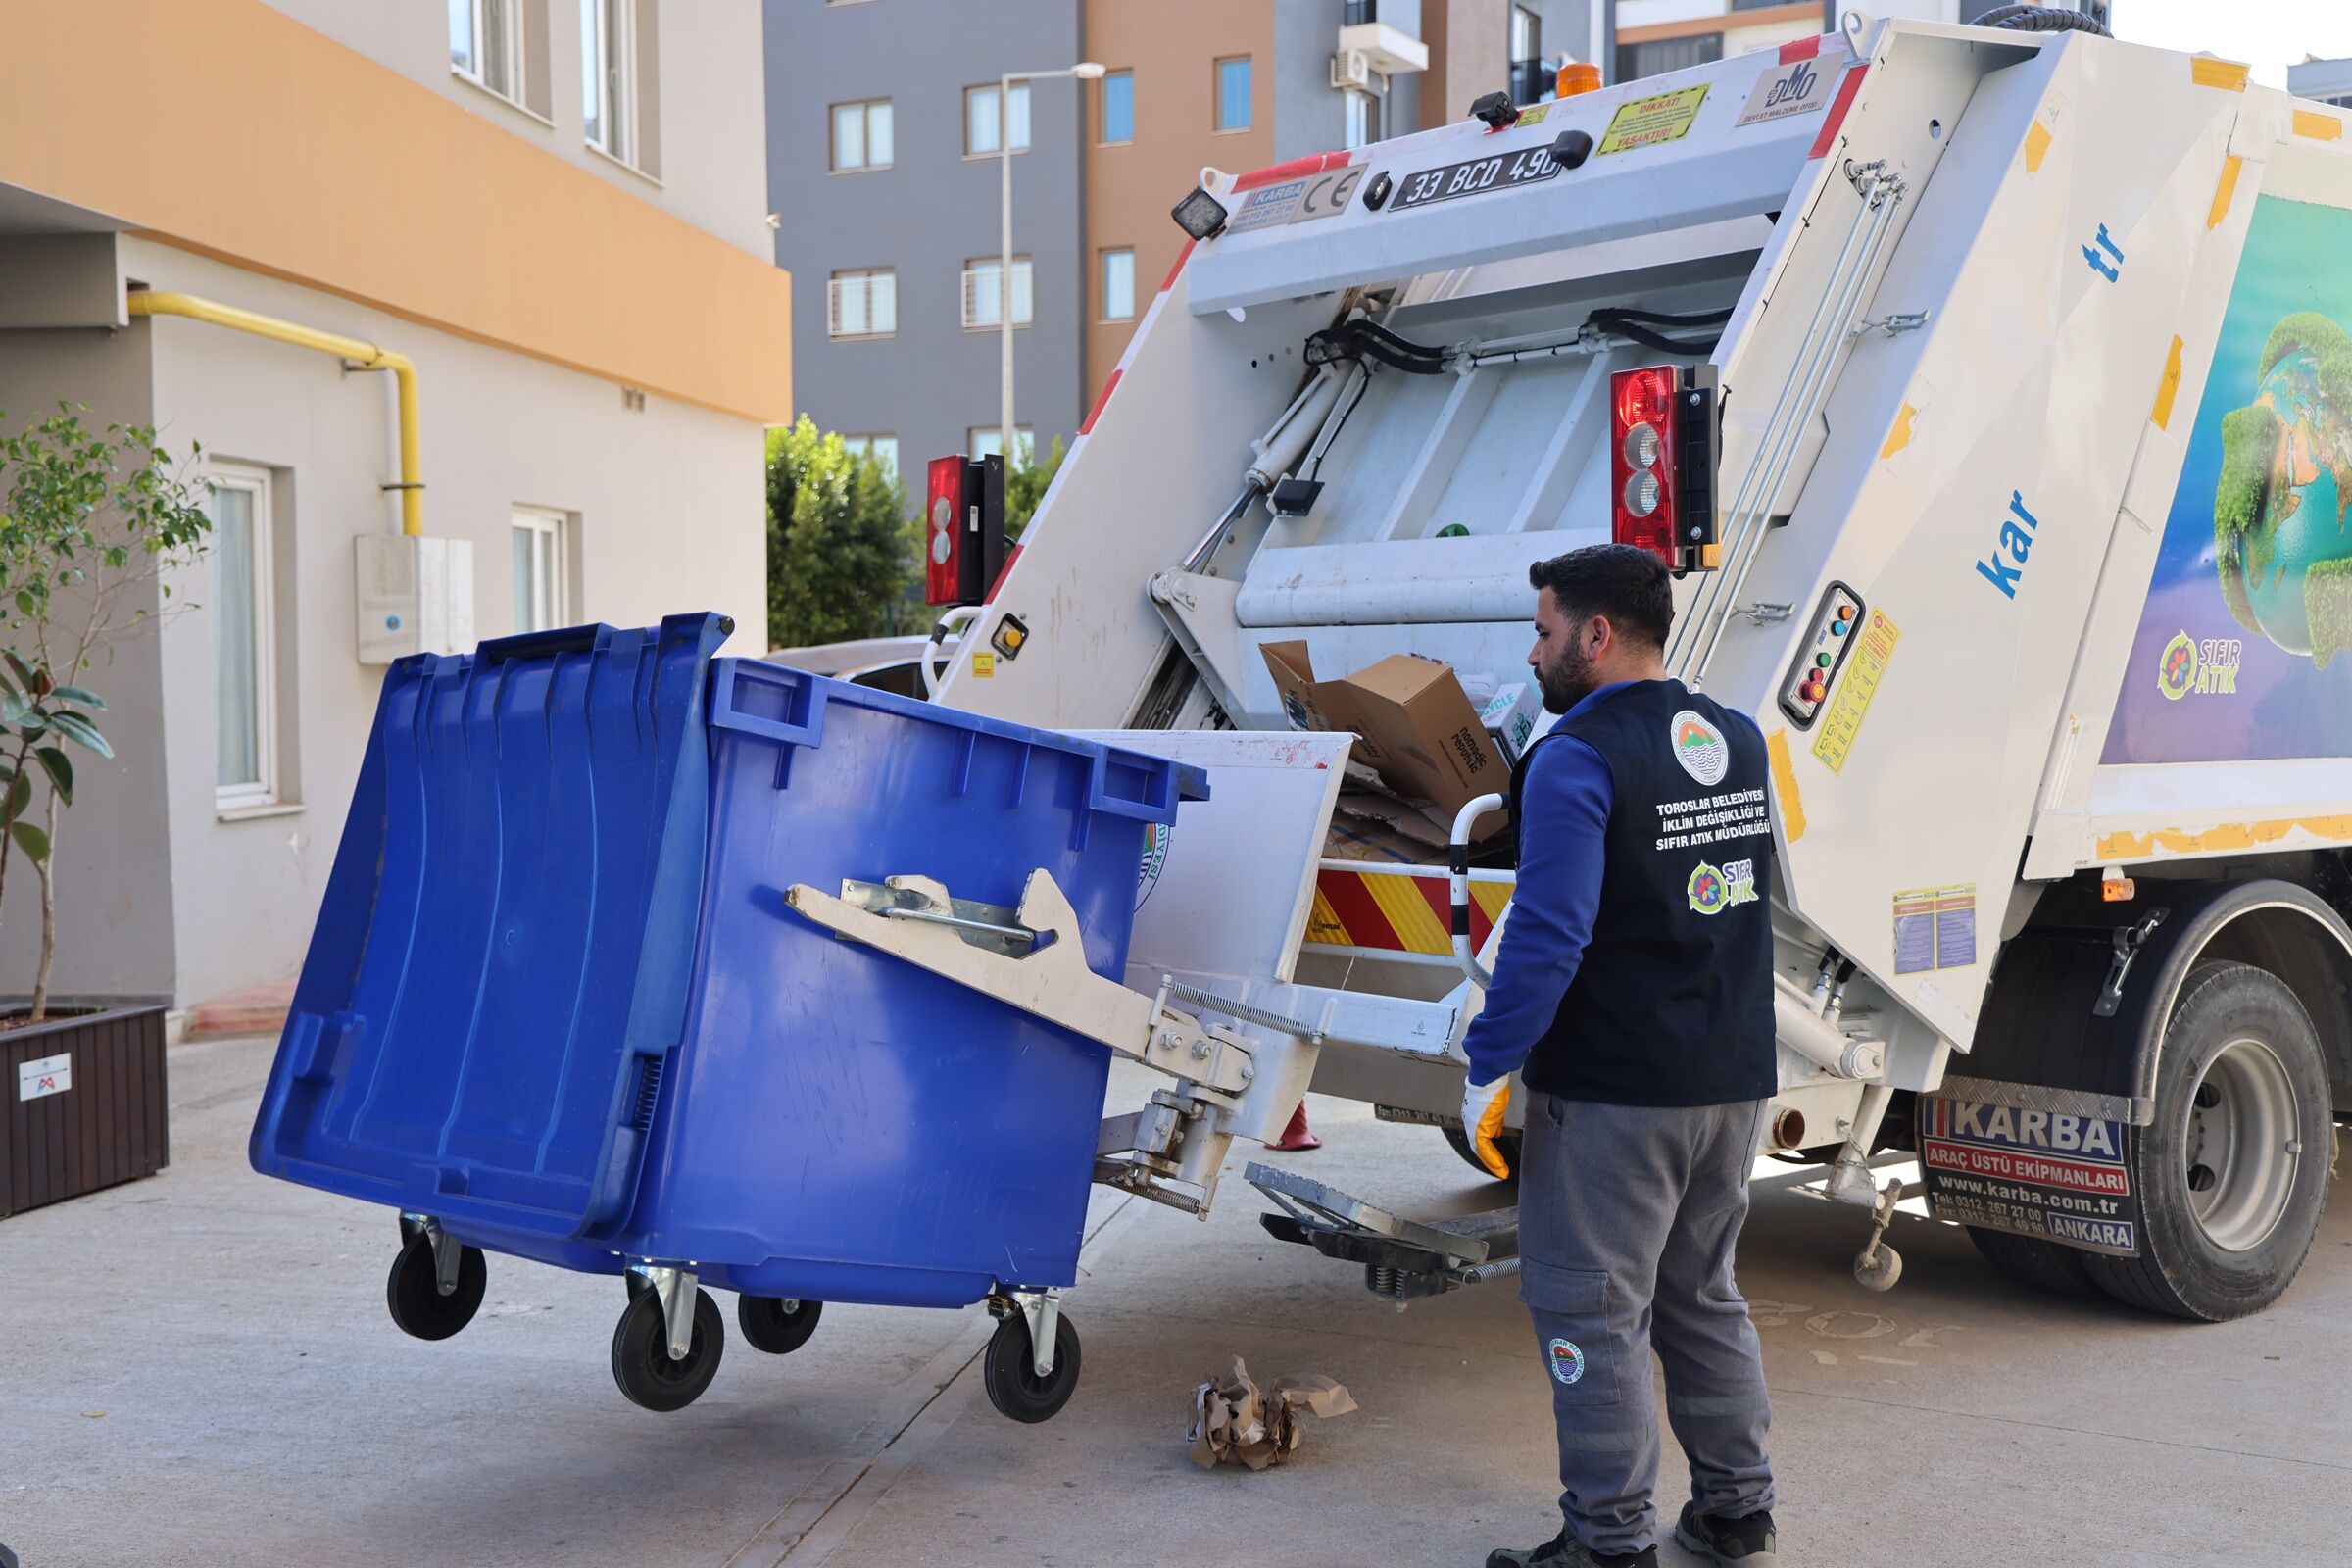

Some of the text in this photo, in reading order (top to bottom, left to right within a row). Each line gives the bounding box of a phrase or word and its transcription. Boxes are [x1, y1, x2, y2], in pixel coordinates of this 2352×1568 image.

[1743, 113, 1767, 122] DEVLET
[1769, 105, 1799, 117] MALZEME
[1255, 183, 1302, 203] KARBA
[1303, 171, 1360, 213] CE
[1406, 171, 1444, 203] 33
[1446, 158, 1502, 194] BCD
[2082, 222, 2125, 283] tr
[1975, 489, 2038, 600] kar
[2199, 639, 2242, 665] SIFIR
[2195, 665, 2239, 694] ATIK
[1451, 733, 1478, 774] republic
[1459, 726, 1487, 767] nomadic
[1656, 787, 1764, 816] TOROSLAR BELEDİYESİ
[1663, 815, 1693, 832] İKLİM
[1696, 805, 1754, 827] DEĞİŞİKLİĞİ
[1147, 823, 1167, 880] DİYESİ
[1656, 819, 1771, 851] SIFIR ATIK MÜDÜRLÜĞÜ
[1954, 1100, 2116, 1157] KARBA
[1930, 1148, 2124, 1190] ARAÇ ÜSTÜ EKİPMANLARI
[1932, 1191, 2042, 1222] Tel: 0312. 267 27 00
[1938, 1176, 2119, 1215] www.karba.com.tr
[2054, 1217, 2130, 1247] ANKARA
